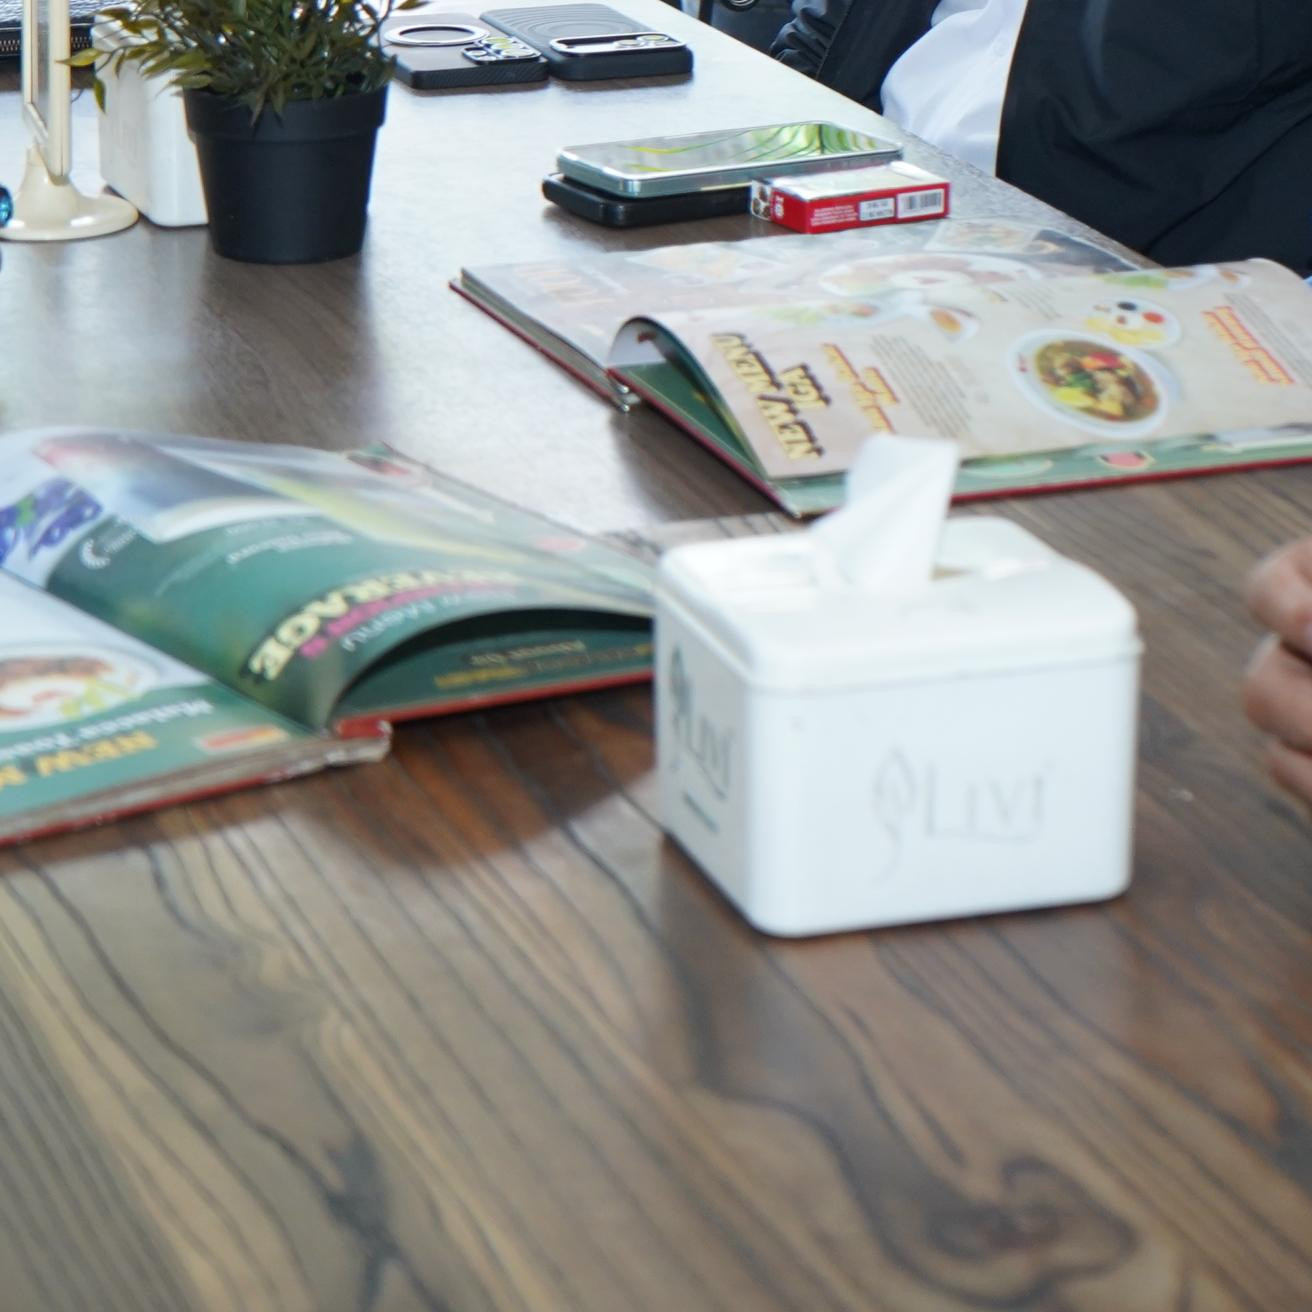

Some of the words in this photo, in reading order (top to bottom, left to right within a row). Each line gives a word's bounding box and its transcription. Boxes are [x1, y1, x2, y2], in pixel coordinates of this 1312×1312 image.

[710, 332, 783, 391] MENU
[779, 362, 832, 409] IGA
[756, 394, 824, 459] NEW
[37, 729, 158, 777] NEW
